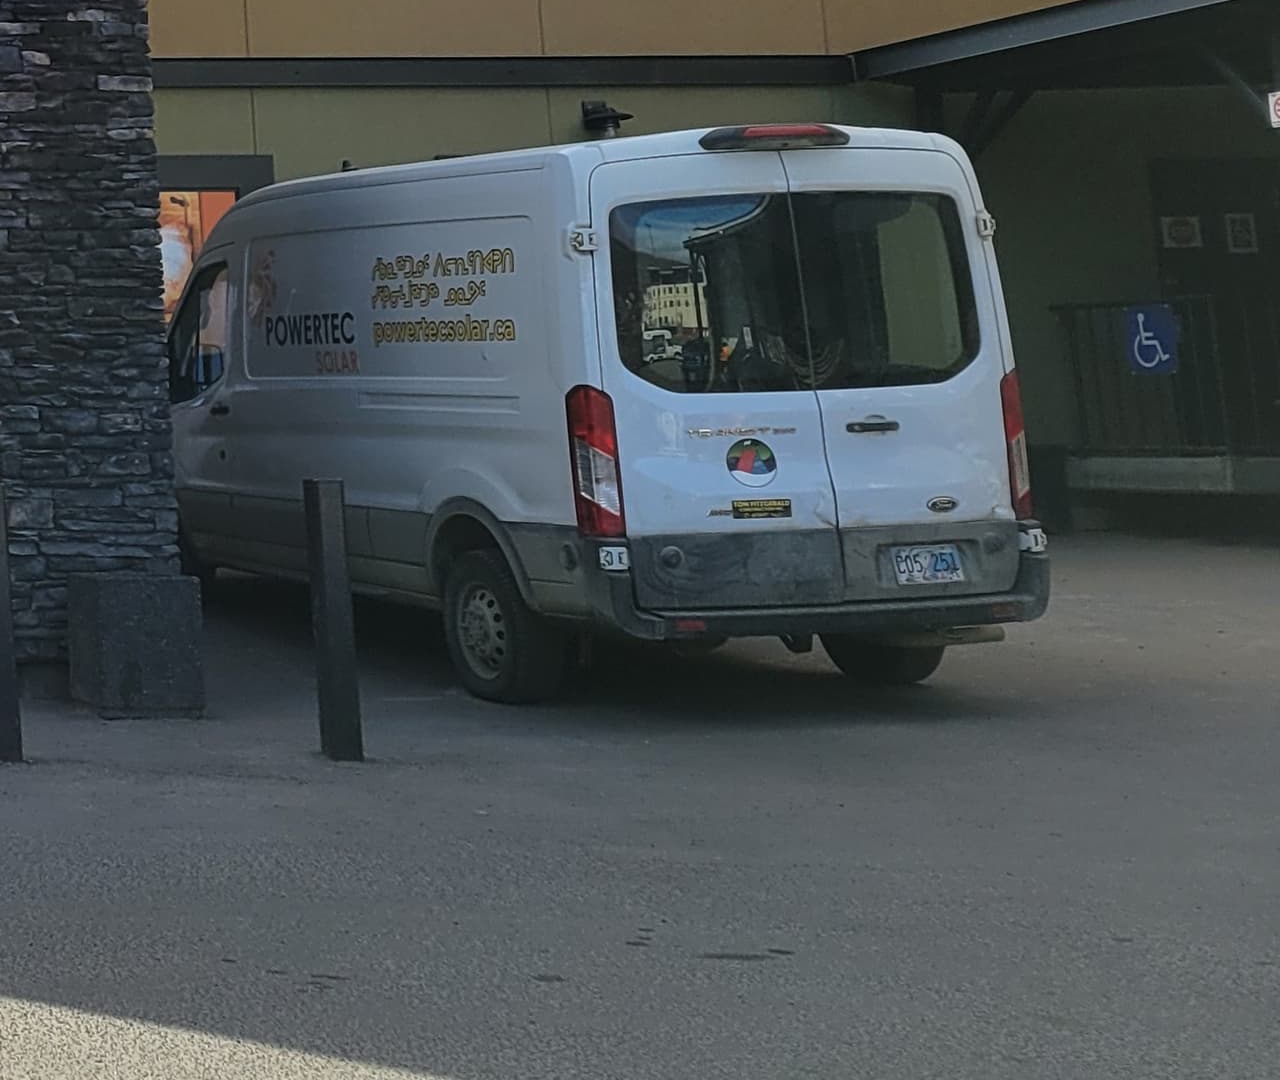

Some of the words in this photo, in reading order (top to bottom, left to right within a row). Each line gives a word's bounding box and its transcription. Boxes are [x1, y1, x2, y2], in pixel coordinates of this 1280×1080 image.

[265, 312, 355, 347] POWERTEC
[373, 314, 516, 347] powertecsolar.ca
[315, 350, 360, 373] SOLAR
